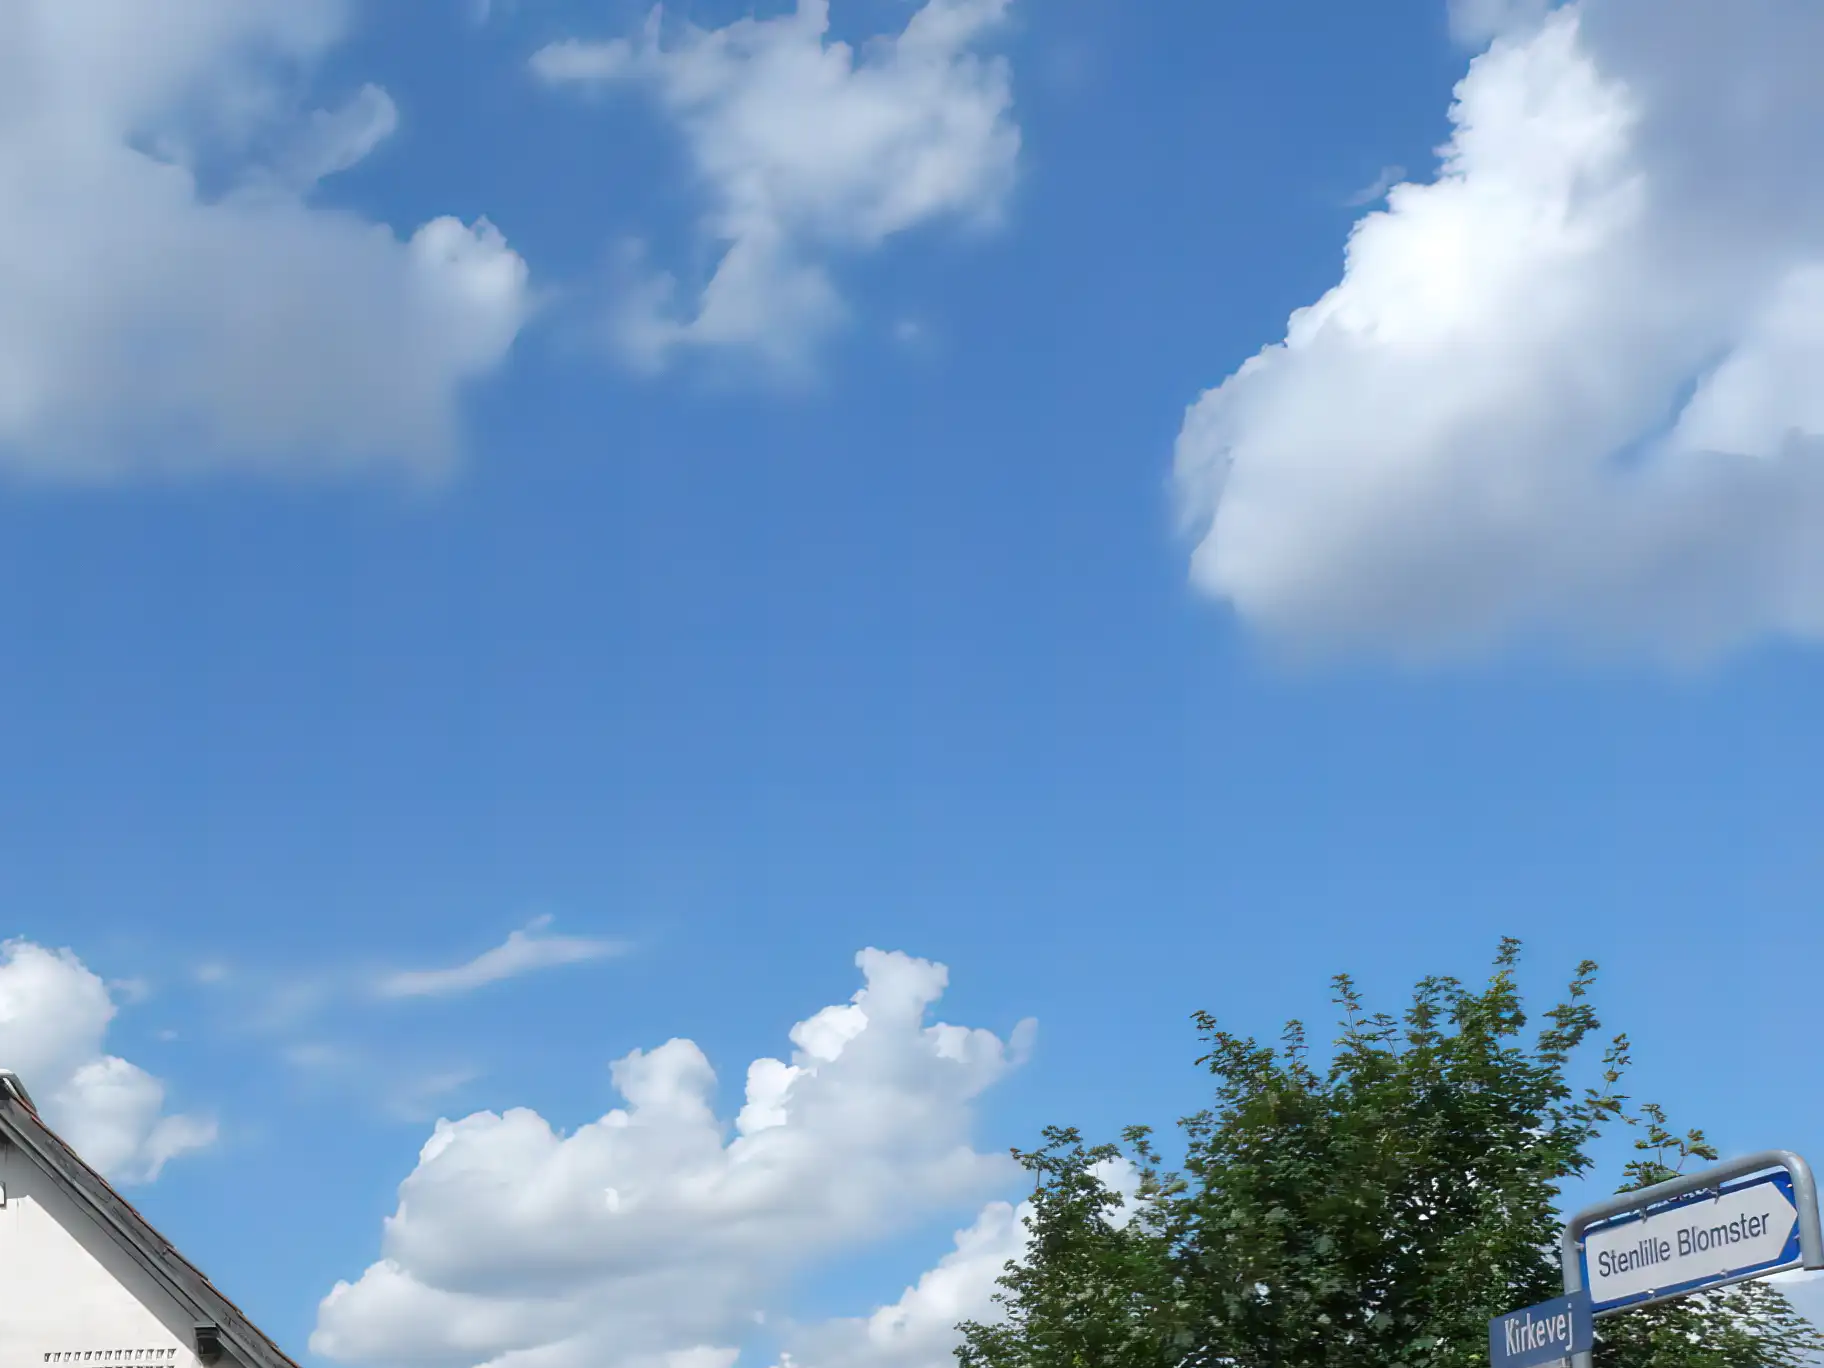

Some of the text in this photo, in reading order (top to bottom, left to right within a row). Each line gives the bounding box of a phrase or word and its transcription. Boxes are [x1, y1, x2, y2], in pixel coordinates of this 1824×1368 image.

[1598, 1212, 1770, 1278] Stenlille Blomster
[1504, 1302, 1573, 1357] Kirkevej
